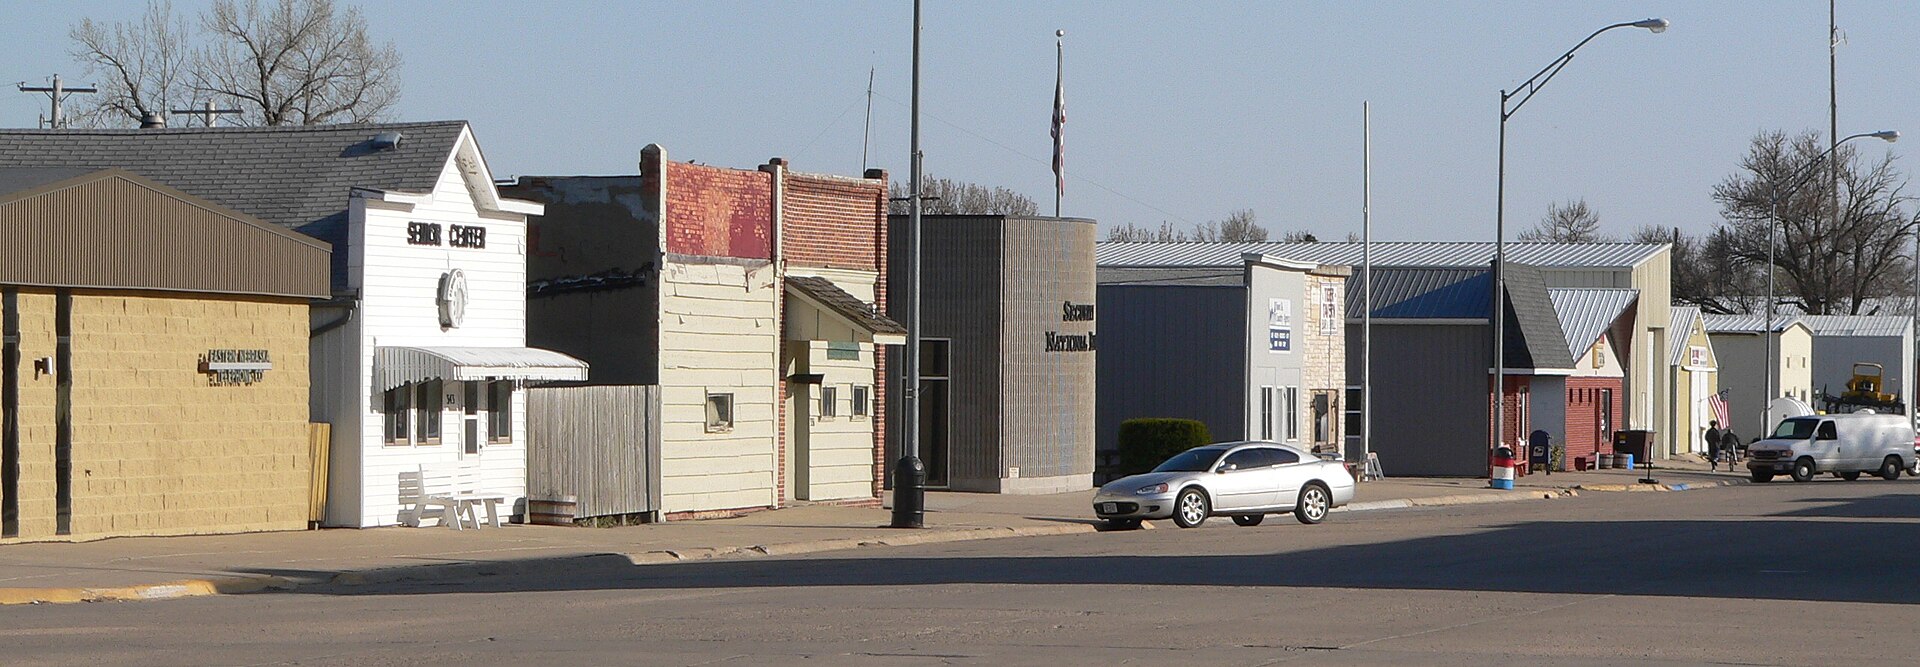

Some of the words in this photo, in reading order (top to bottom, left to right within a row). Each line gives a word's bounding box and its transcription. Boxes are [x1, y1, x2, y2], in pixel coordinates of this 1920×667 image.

[407, 221, 441, 246] SENIOR
[449, 224, 486, 249] CENTER
[208, 349, 236, 363] EASTERN
